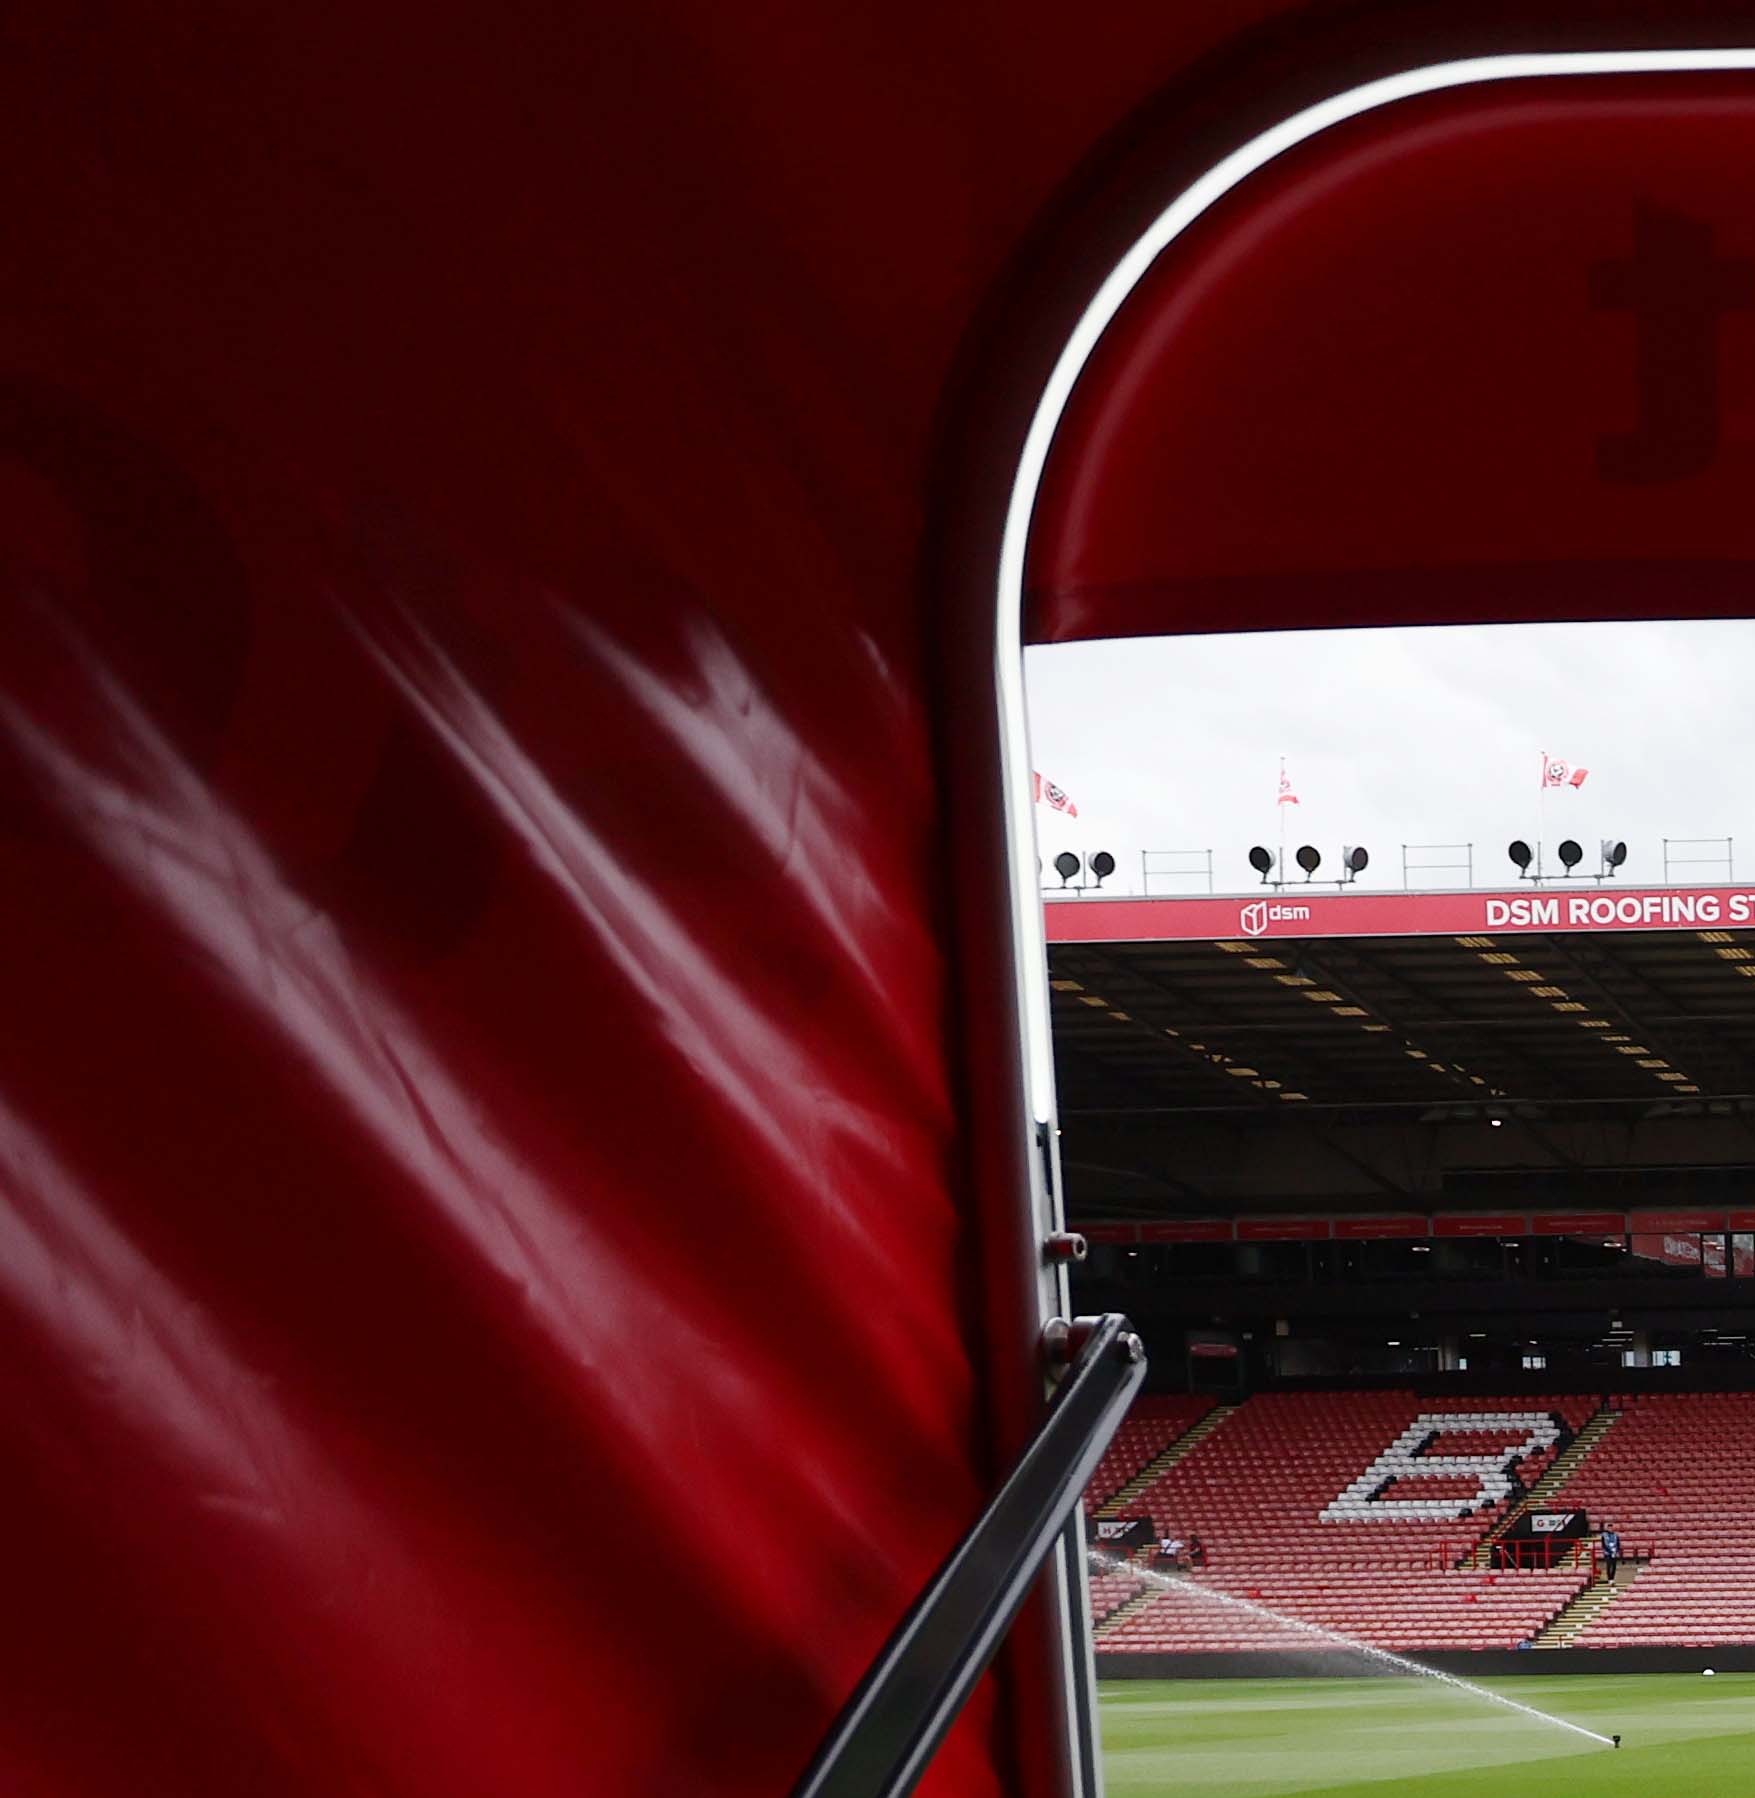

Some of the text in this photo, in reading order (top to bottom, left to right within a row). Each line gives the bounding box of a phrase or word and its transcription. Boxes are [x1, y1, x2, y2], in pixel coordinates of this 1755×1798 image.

[1268, 904, 1310, 921] dsm
[1486, 899, 1560, 926] DSM
[1568, 895, 1721, 925] ROOFING
